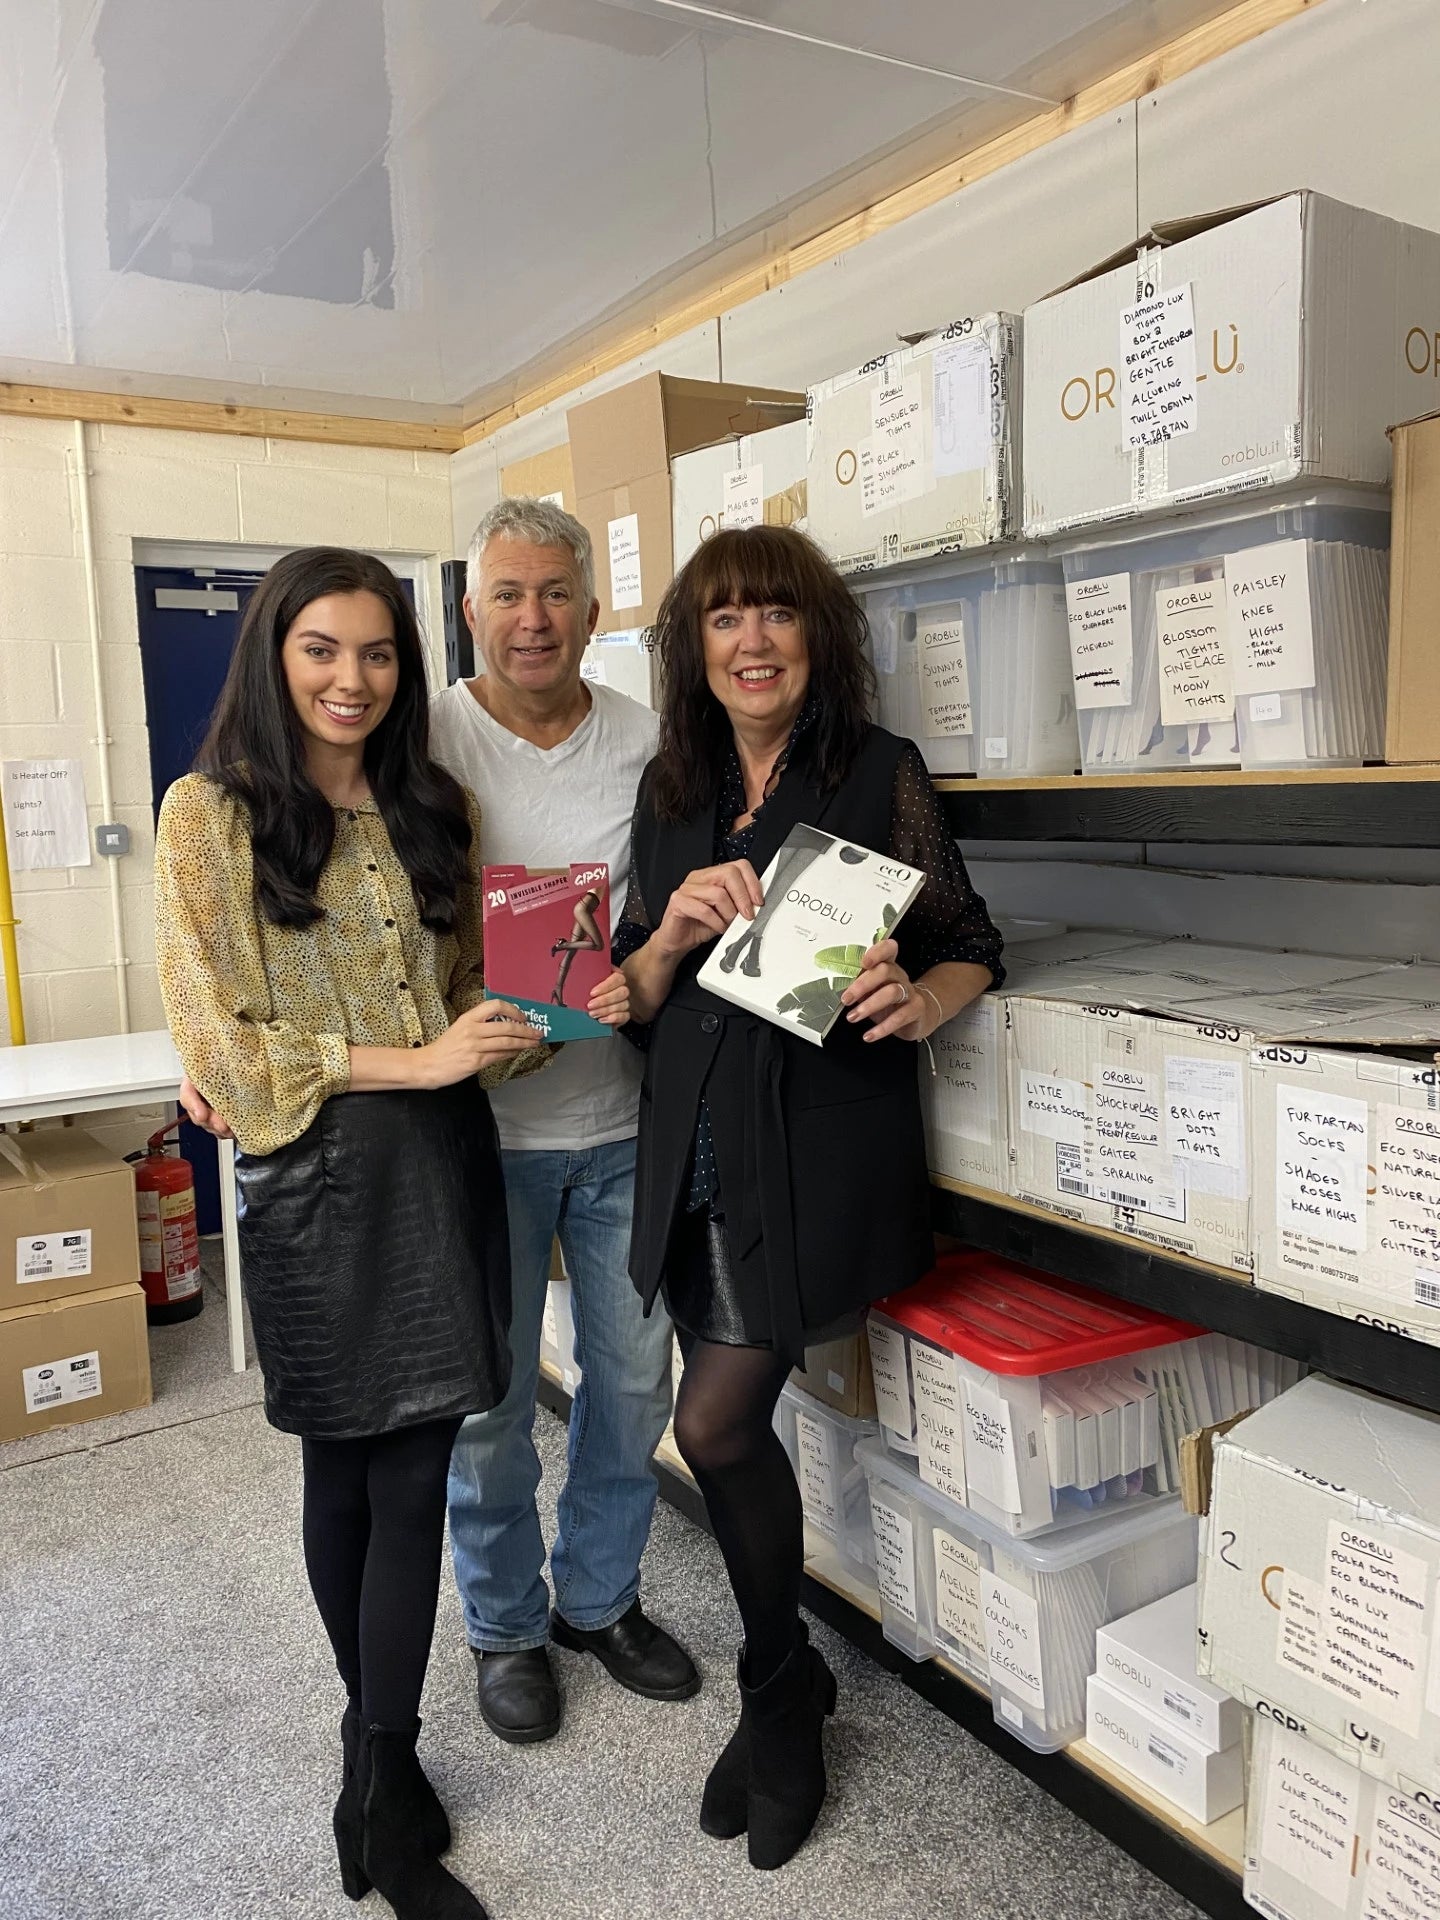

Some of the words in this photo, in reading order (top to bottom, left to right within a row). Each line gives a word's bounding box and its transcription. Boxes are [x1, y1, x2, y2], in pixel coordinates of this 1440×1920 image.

[1124, 301, 1164, 325] DIAMOND
[1167, 293, 1184, 309] LUX
[1136, 314, 1165, 330] TIGHTS
[1133, 333, 1152, 345] BOX
[1154, 326, 1162, 336] 2
[1125, 345, 1156, 365] BRIGHT
[1129, 357, 1174, 384] GENTLE
[879, 386, 903, 400] OROBLU
[1131, 379, 1182, 406] ALLURING
[875, 408, 908, 428] SENSUEL
[909, 402, 919, 411] 20
[1130, 410, 1158, 425] TWILL
[1160, 395, 1193, 415] DENIM
[887, 422, 911, 437] TIGHTS
[1130, 435, 1147, 446] FUR
[1150, 420, 1189, 441] TARTAN
[876, 450, 899, 465] BLACK
[1221, 439, 1280, 467] oroblu.it
[878, 459, 915, 481] SINGAPOUR
[880, 485, 895, 495] SUN
[611, 529, 624, 540] LACY
[1077, 582, 1109, 596] OROBLU
[1232, 574, 1288, 597] PAISLEY
[1166, 592, 1212, 609] OROBLU
[1069, 613, 1083, 622] ECO
[1085, 608, 1106, 620] BLACK
[1107, 604, 1127, 614] LINES
[1241, 604, 1274, 621] KNEE
[924, 629, 959, 644] OROBLU
[1249, 624, 1284, 639] HIGHS
[1076, 640, 1114, 654] CHEVRON
[1177, 642, 1220, 657] TIGHTS
[934, 676, 960, 688] TIGHTS
[1173, 680, 1210, 694] MOONY
[928, 703, 970, 715] TEMPTATION
[1185, 694, 1226, 708] TIGHTS
[935, 714, 967, 725] SUSPENDER
[51, 771, 68, 779] Off?
[14, 801, 42, 809] Lights?
[31, 829, 55, 837] Alarm
[575, 866, 607, 886] GIPSY
[511, 885, 542, 900] INVISIBLE
[544, 877, 568, 889] SHAPER
[488, 889, 506, 908] 20
[939, 1040, 984, 1055] SENSUEL
[948, 1057, 972, 1070] LACE
[944, 1075, 977, 1091] TIGHTS
[1102, 1070, 1144, 1085] OROBLU
[1027, 1082, 1063, 1099] LITTLE
[1028, 1101, 1059, 1114] ROSES
[1170, 1106, 1221, 1121] BRIGHT
[1187, 1124, 1216, 1137] DOTS
[1287, 1108, 1312, 1122] FUR
[1315, 1114, 1364, 1134] TARTAN
[1099, 1147, 1138, 1162] GAITER
[1177, 1138, 1221, 1157] TIGHTS
[1380, 1142, 1406, 1156] ECO
[1103, 1167, 1154, 1185] SPIRALING
[1284, 1162, 1340, 1185] SHADED
[1300, 1184, 1342, 1202] ROSES
[1381, 1185, 1423, 1204] SILVER
[1291, 1199, 1321, 1216] KNEE
[1326, 1208, 1358, 1223] HIGHS
[1193, 1218, 1247, 1241] oroblu.it
[1389, 1219, 1437, 1238] TEXTURE
[1380, 1238, 1431, 1259] GLITTER
[1283, 1254, 1314, 1269] Consegna
[916, 1369, 932, 1384] ALL
[920, 1414, 956, 1440] SILVER
[966, 1403, 980, 1419] ECO
[982, 1414, 1007, 1435] BLACK
[930, 1440, 951, 1454] LACE
[974, 1432, 1006, 1455] DELIGHT
[928, 1459, 952, 1479] KNEE
[936, 1478, 962, 1501] HIGHS
[1220, 1530, 1243, 1571] 2
[1340, 1531, 1393, 1559] OROBLU
[941, 1539, 979, 1571] OROBLU
[1331, 1550, 1364, 1570] POLKA
[1369, 1564, 1400, 1585] DOTS
[939, 1569, 977, 1599] ADELLE
[1331, 1565, 1351, 1582] ECO
[1359, 1575, 1388, 1595] BLACK
[992, 1589, 1010, 1609] ALL
[1331, 1586, 1359, 1607] RIGA
[1366, 1603, 1389, 1621] LUX
[985, 1607, 1028, 1640] COLOURS
[1330, 1607, 1389, 1641] SAVANNAH
[997, 1629, 1014, 1650] 50
[1336, 1626, 1372, 1650] CAMEL
[1326, 1639, 1383, 1675] SAVANNAH
[990, 1647, 1041, 1687] LEGGINGS
[1330, 1655, 1354, 1674] GREY
[1357, 1670, 1400, 1700] SERPENT
[1278, 1757, 1300, 1776] ALL
[1302, 1772, 1348, 1804] COLOURS
[1281, 1780, 1306, 1801] LINE
[1312, 1798, 1347, 1826] TIGHTS
[1377, 1819, 1399, 1838] ECO
[1379, 1836, 1426, 1869] NATURAL
[1376, 1856, 1420, 1886] GLITTER
